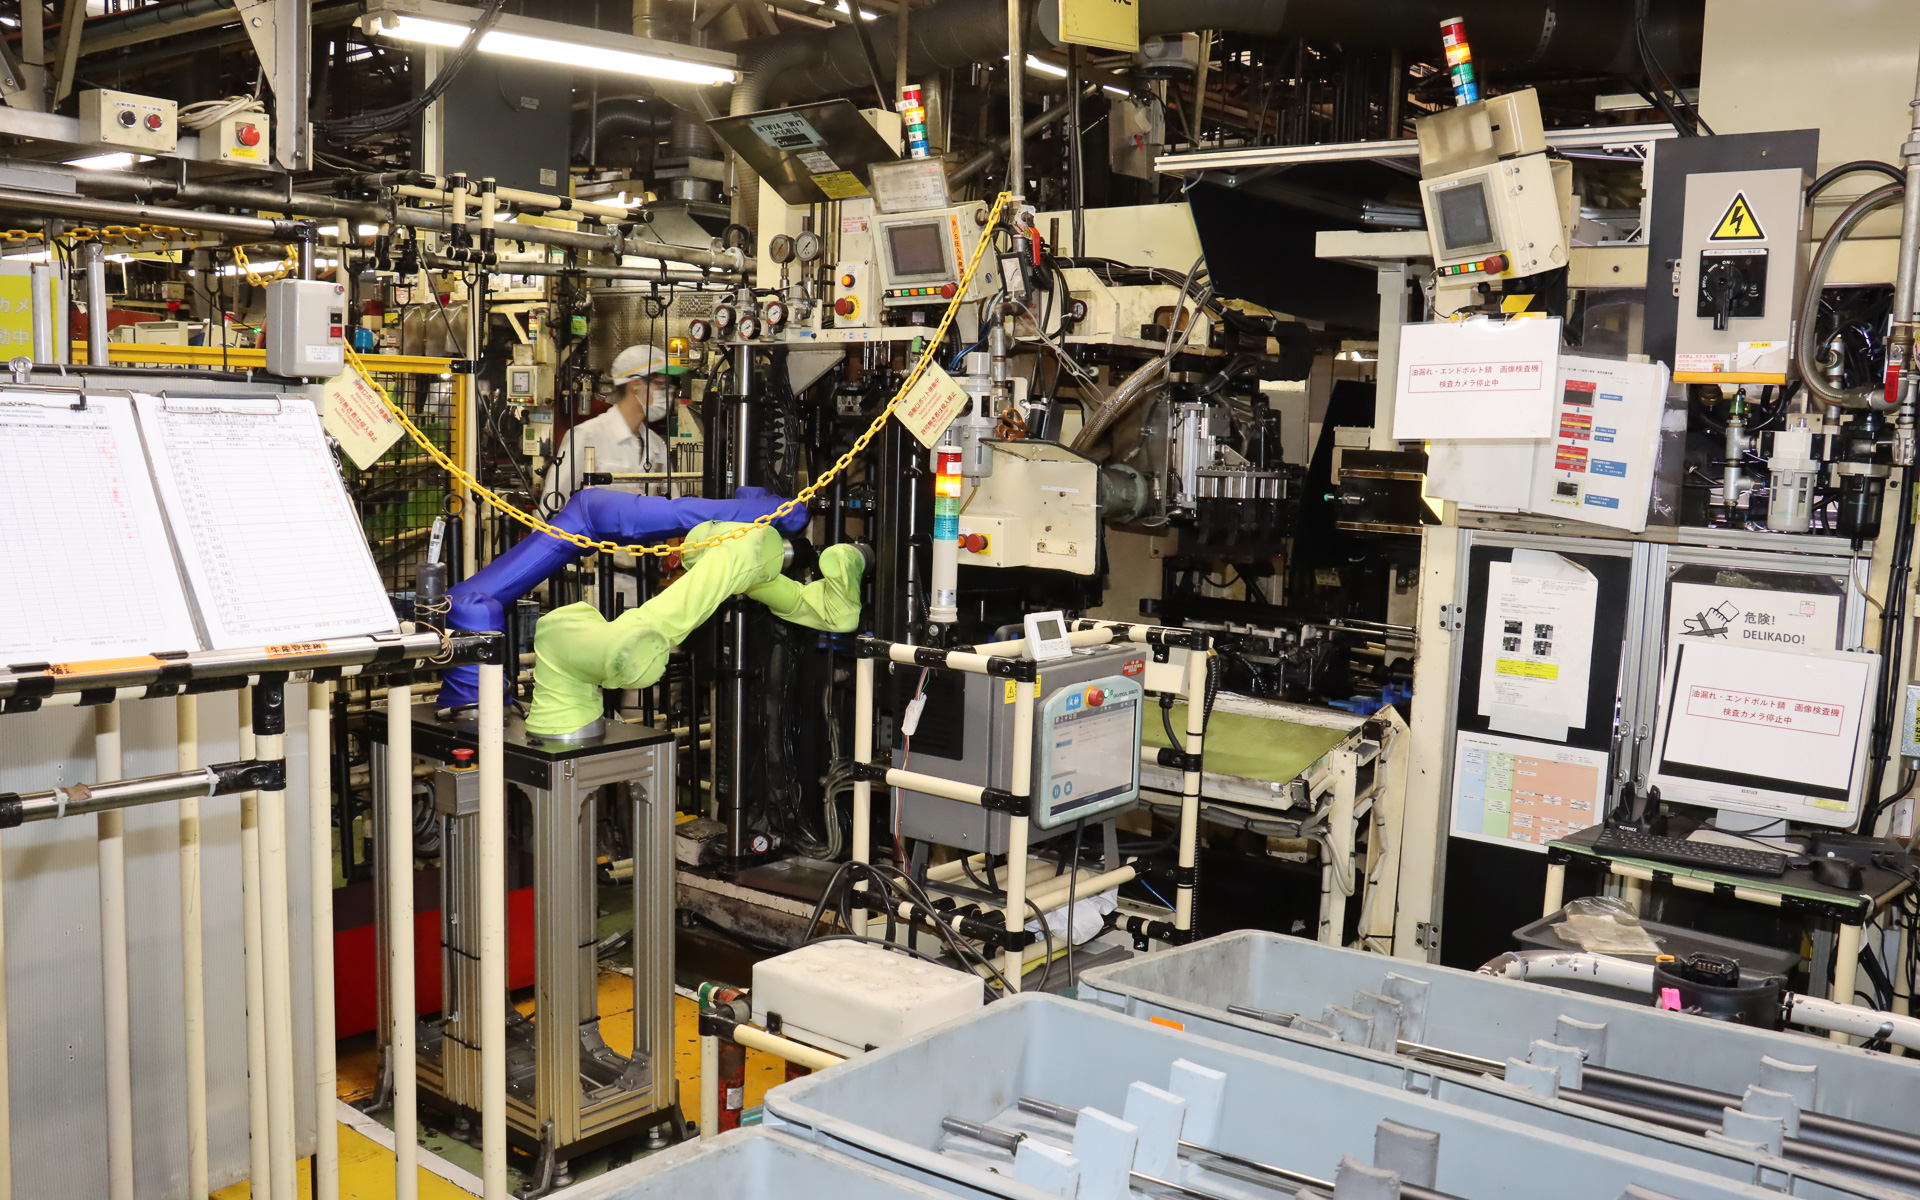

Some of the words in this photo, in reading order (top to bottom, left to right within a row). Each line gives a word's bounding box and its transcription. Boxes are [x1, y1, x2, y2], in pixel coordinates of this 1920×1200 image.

[1499, 364, 1539, 374] 画像検査機
[1439, 378, 1499, 388] 検査カメラ停止中
[1744, 611, 1776, 626] 危険!
[1742, 629, 1806, 645] DELIKADO!
[1691, 689, 1786, 709] 油漏れ・エンドボルト錆
[1794, 703, 1840, 718] 画像検査機
[1723, 708, 1792, 724] 検査カメラ停止中
